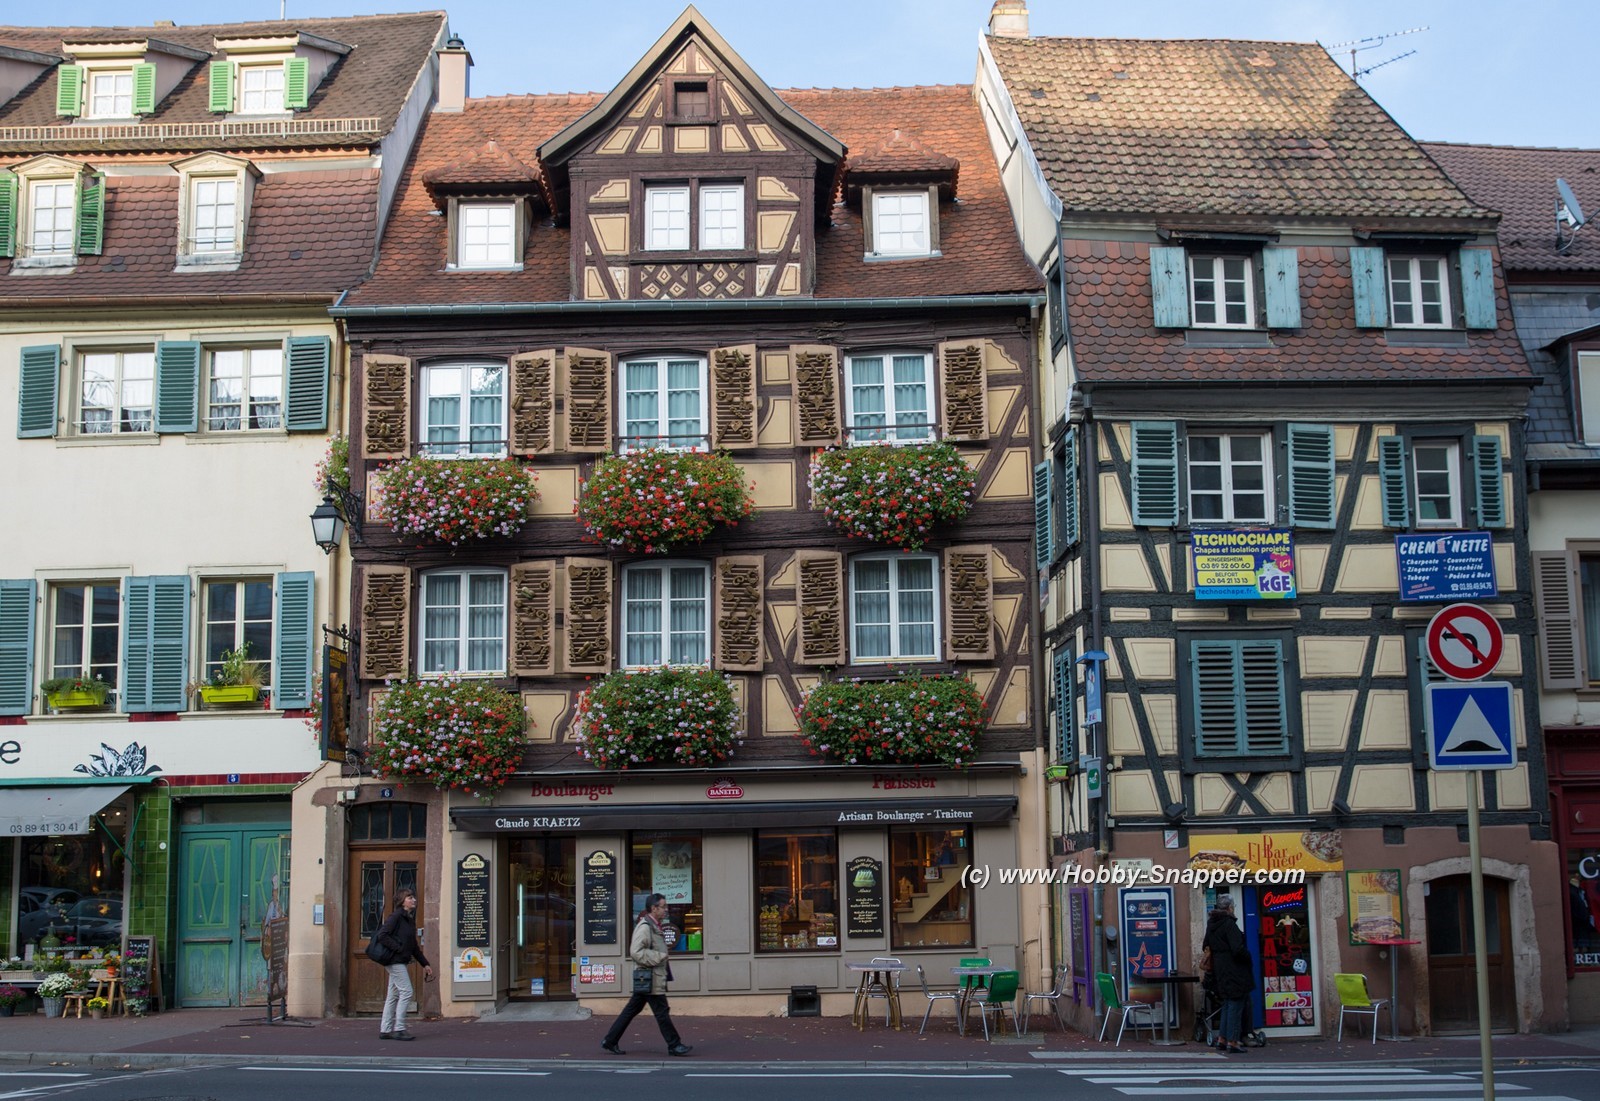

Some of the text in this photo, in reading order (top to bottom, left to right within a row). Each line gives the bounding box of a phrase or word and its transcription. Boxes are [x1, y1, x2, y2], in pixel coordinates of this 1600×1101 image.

[1193, 533, 1290, 546] TECHNOCHAPE
[1261, 545, 1290, 554] projetée
[1279, 560, 1291, 568] ICI
[1406, 558, 1439, 566] Charpente
[1407, 566, 1439, 574] Zinguerie
[1418, 592, 1479, 600] www.cheminette.fr
[531, 780, 615, 801] Boulanger
[837, 812, 873, 822] Artisan
[877, 810, 925, 823] Boulanger
[933, 809, 973, 819] Traiteur
[10, 823, 78, 833] 03 89 41 30 41
[495, 817, 581, 828] Claude KRAETZ
[1248, 842, 1261, 865] El
[1263, 888, 1304, 907] Ouvert
[1143, 954, 1162, 968] 25
[1272, 997, 1307, 1009] AMIGO
